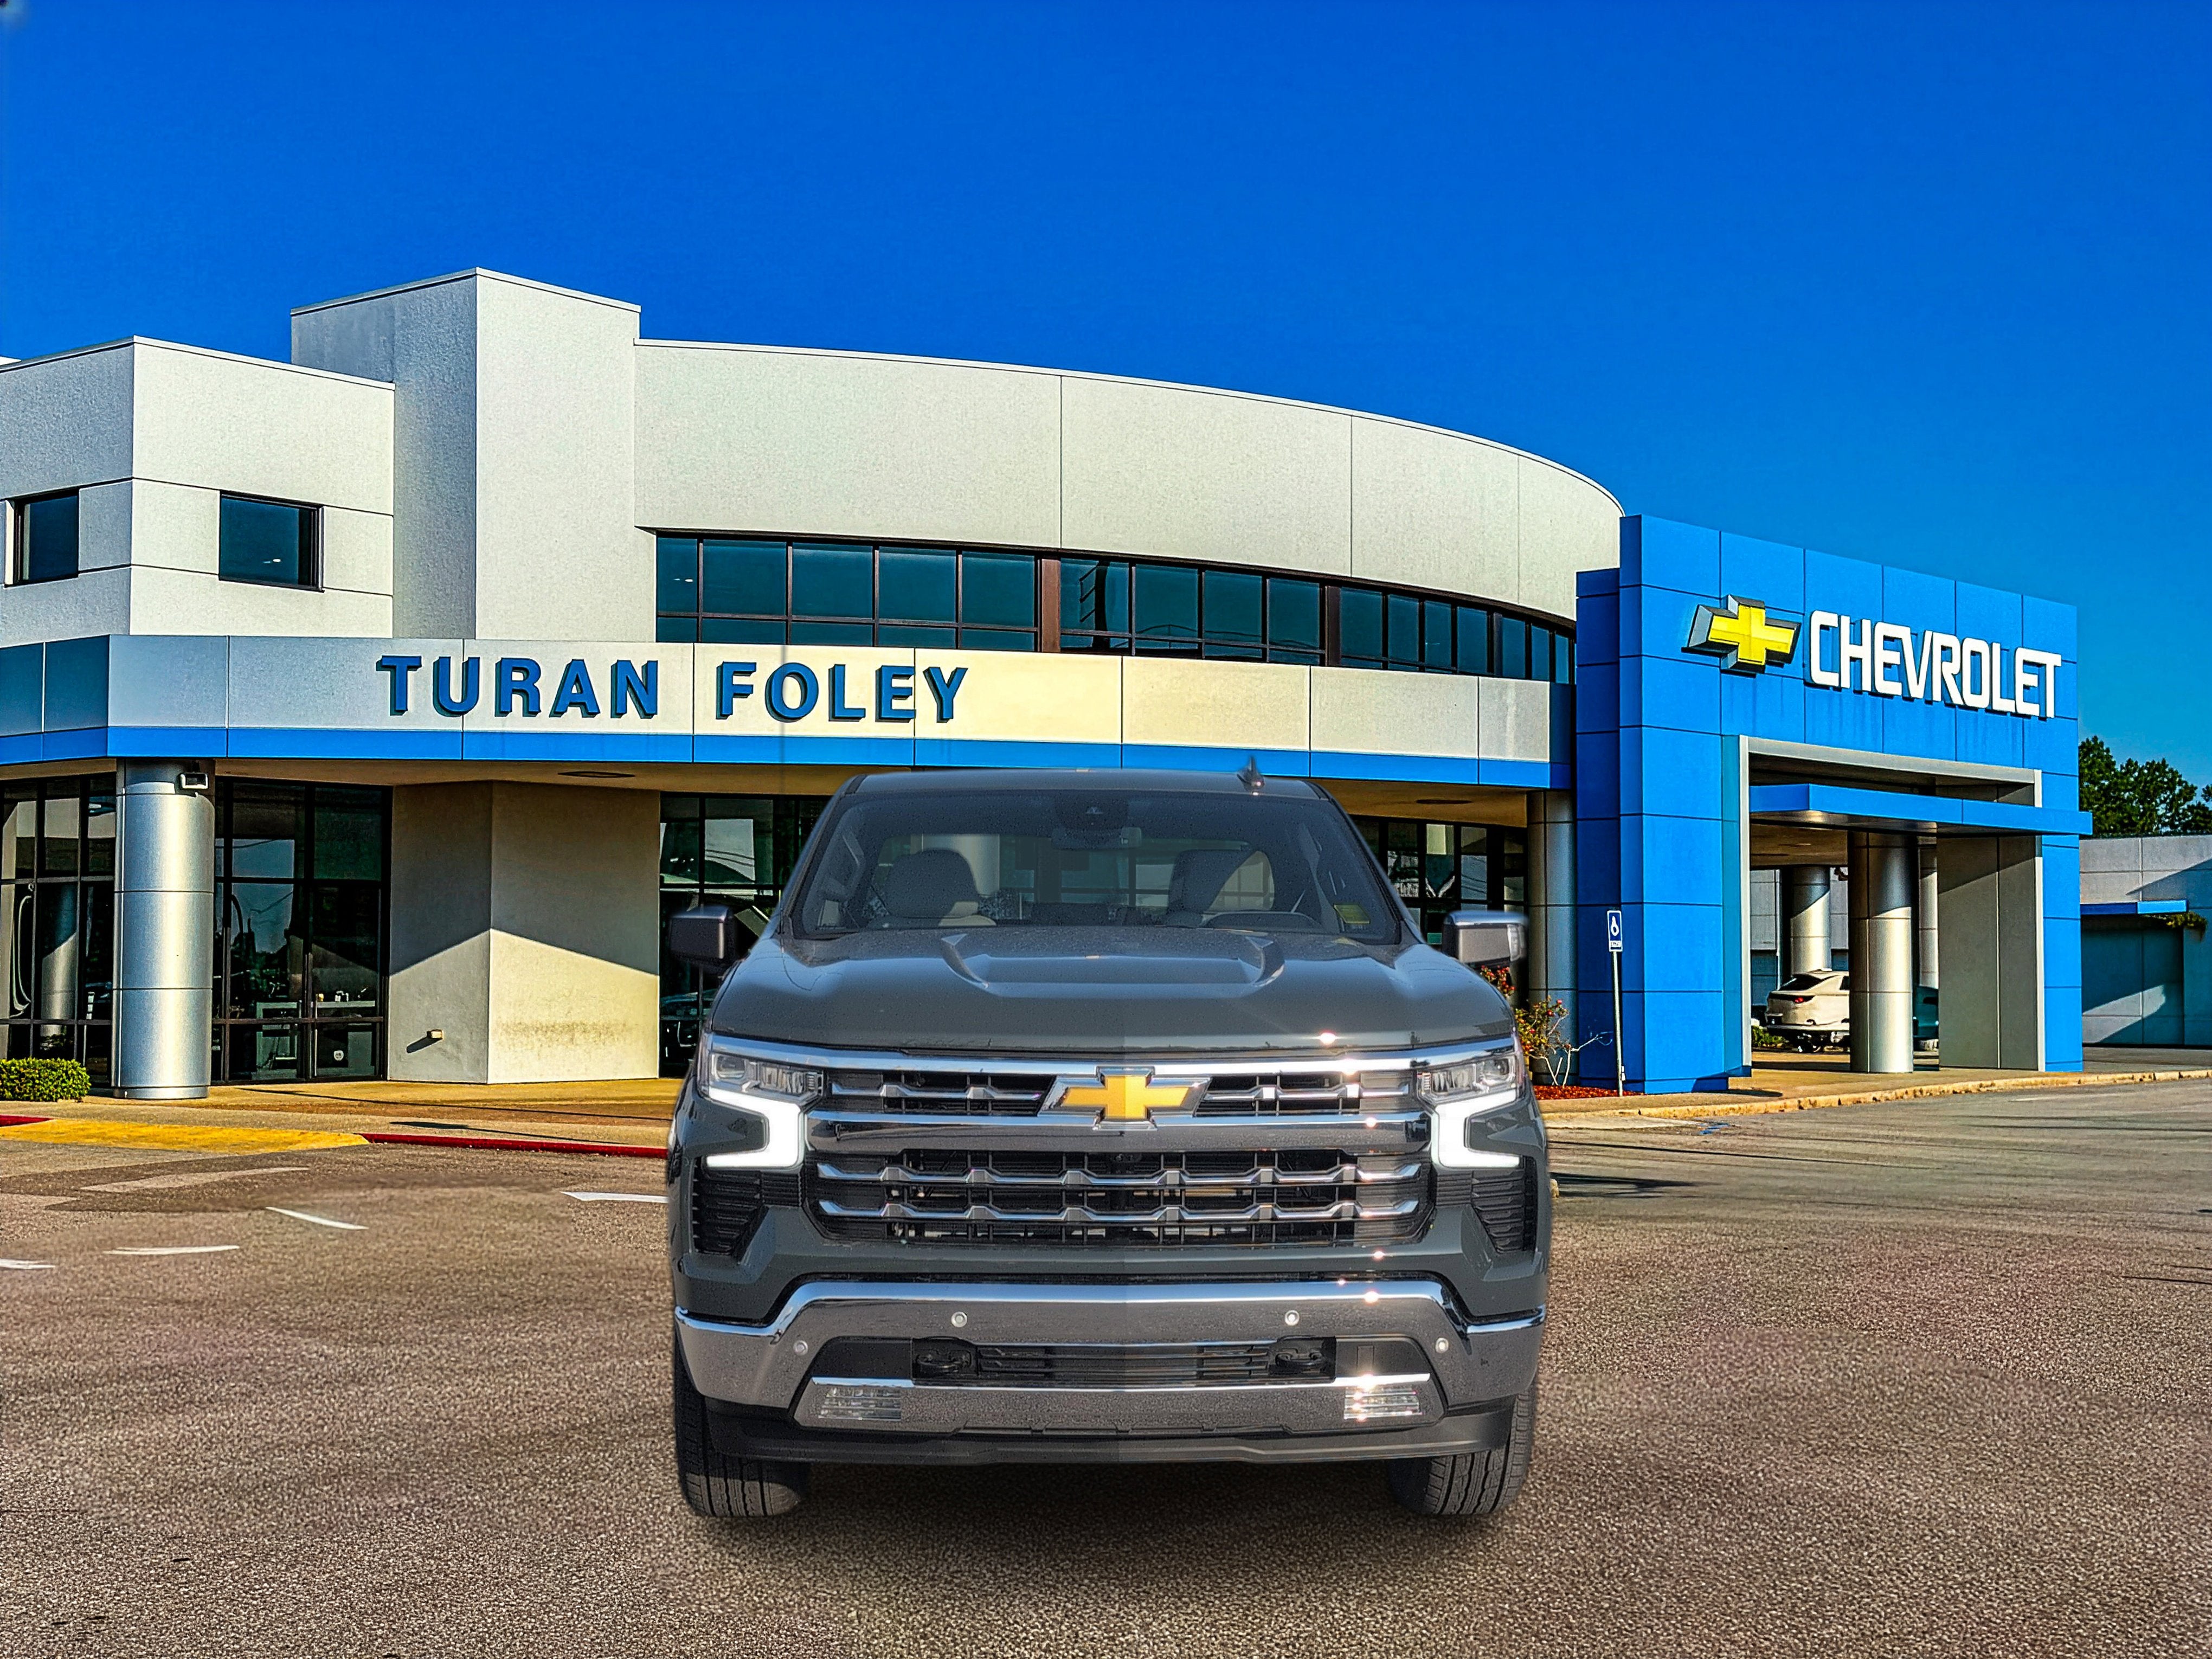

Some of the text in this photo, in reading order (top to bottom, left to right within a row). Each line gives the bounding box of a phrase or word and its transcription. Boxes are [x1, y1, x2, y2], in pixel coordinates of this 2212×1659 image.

[377, 655, 968, 723] TURAN FOLEY
[1808, 610, 2062, 718] CHEVROLET
